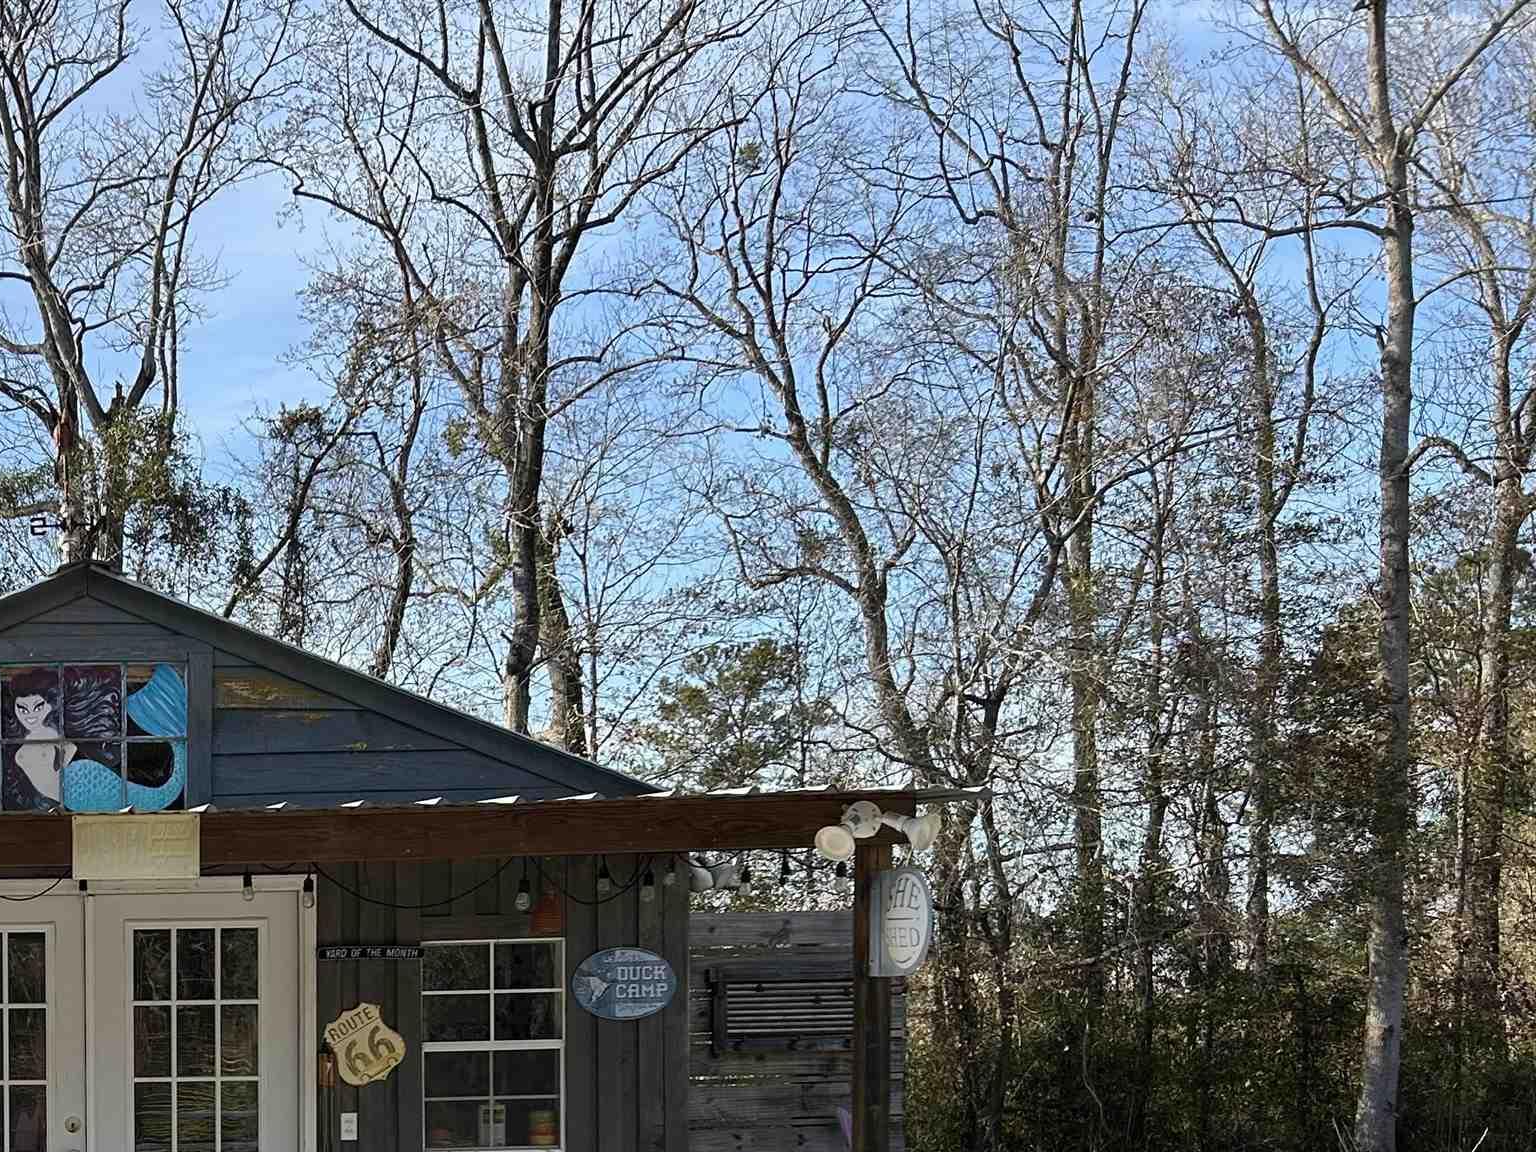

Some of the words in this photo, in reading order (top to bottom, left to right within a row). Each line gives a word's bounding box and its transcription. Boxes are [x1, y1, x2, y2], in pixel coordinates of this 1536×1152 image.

[886, 927, 921, 948] HED
[350, 948, 362, 957] OF
[366, 948, 382, 957] THE
[386, 948, 419, 958] MONTH
[616, 965, 667, 981] DUCK
[615, 983, 669, 999] CAMP
[327, 1006, 374, 1043] ROUTE
[344, 1024, 397, 1077] 66
